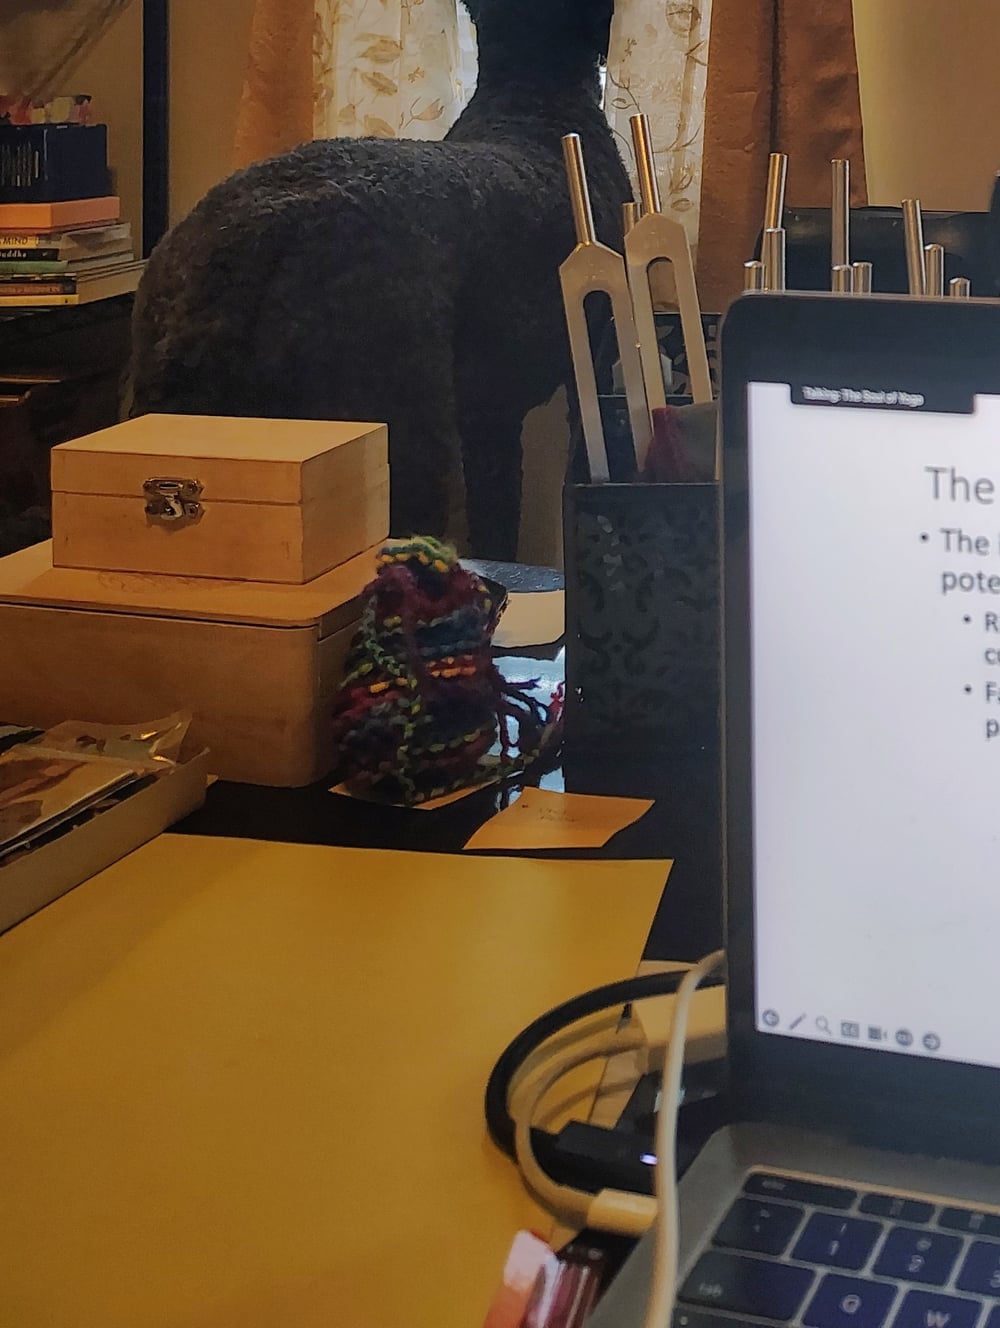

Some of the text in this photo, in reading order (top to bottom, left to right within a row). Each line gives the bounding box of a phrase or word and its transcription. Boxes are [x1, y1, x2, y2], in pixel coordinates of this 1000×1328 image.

[925, 466, 994, 504] The
[940, 527, 990, 555] The
[829, 1239, 841, 1257] 1
[908, 1254, 926, 1274] 2
[925, 1308, 950, 1328] W
